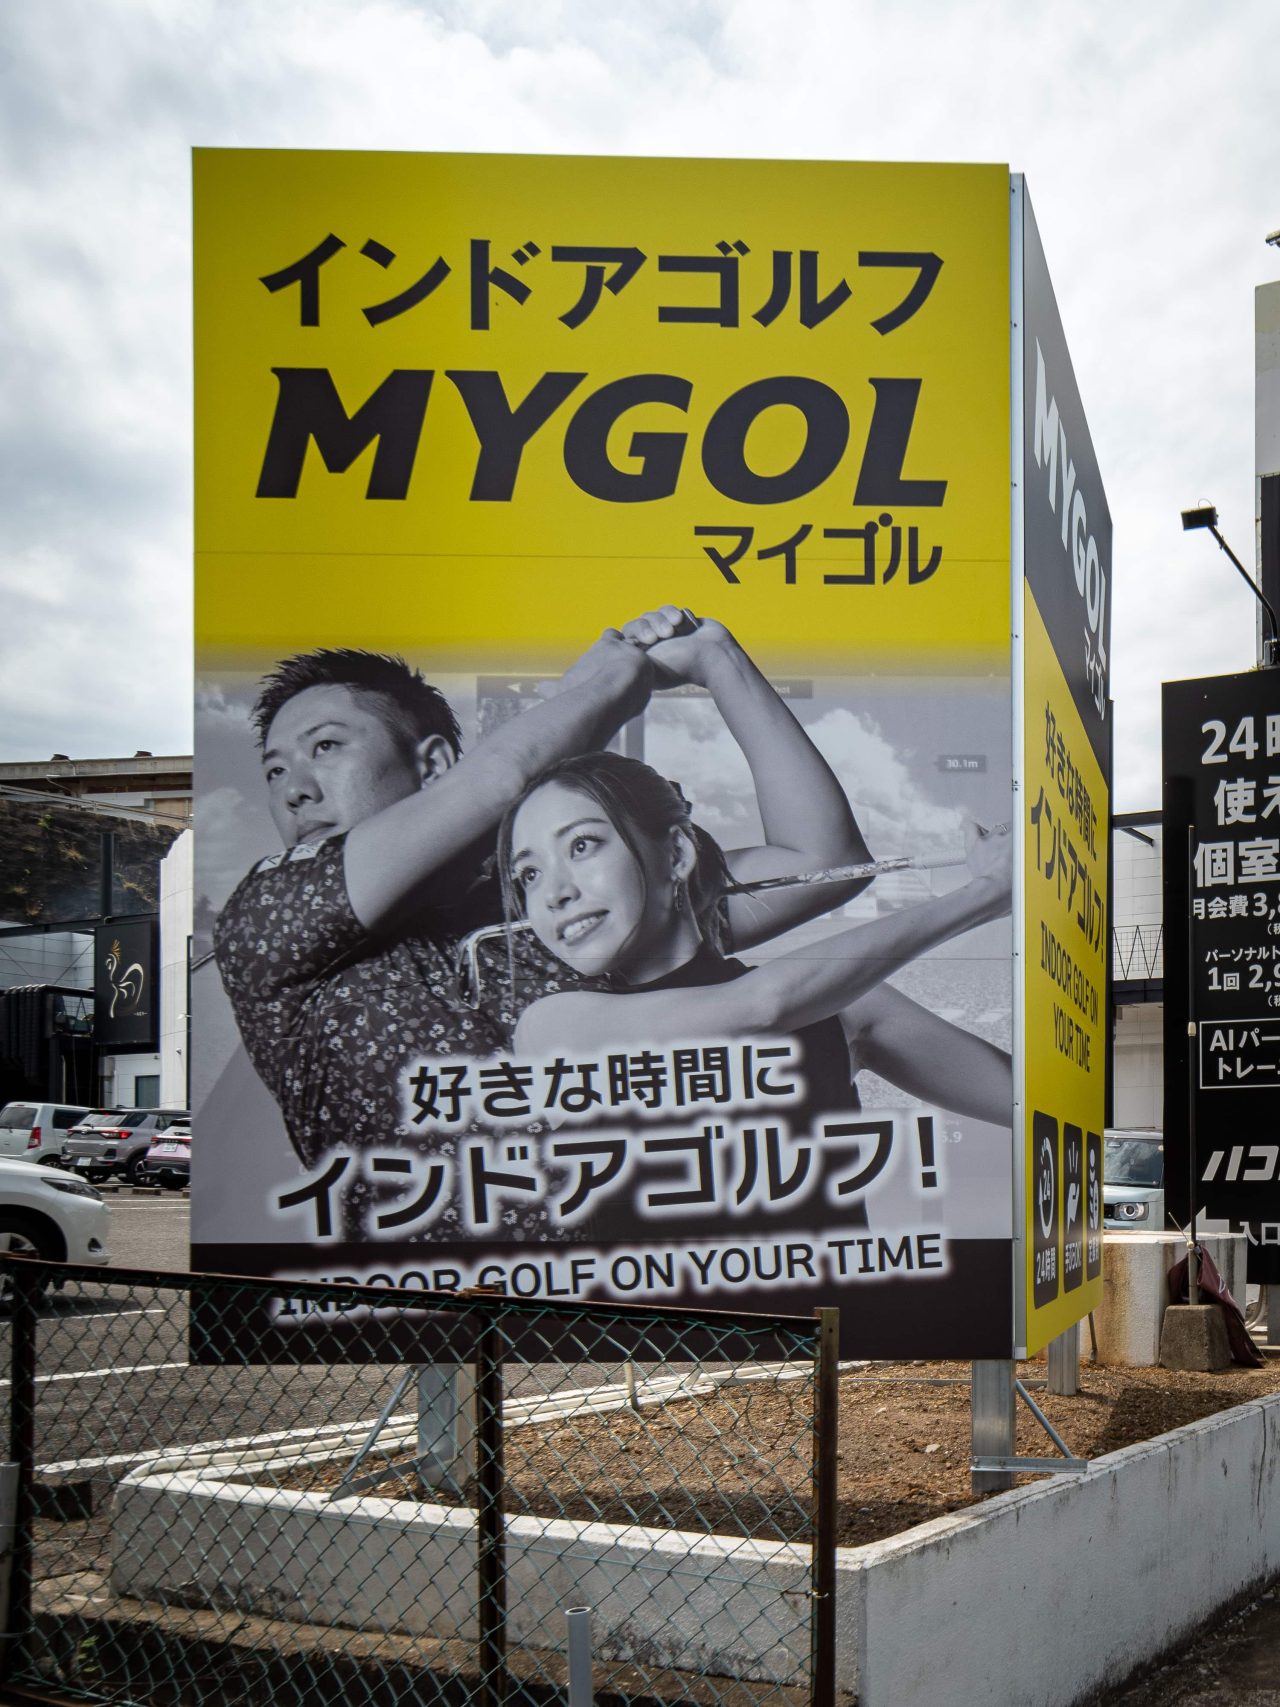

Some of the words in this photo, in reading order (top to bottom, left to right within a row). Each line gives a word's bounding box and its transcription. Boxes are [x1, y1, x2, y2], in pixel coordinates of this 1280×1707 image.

[258, 232, 945, 337] インドアゴルフ
[254, 366, 948, 508] MYGOL
[694, 513, 943, 585] マイゴル
[1034, 335, 1107, 674] MYGOL
[1044, 700, 1099, 862] 好きな時間に
[410, 1045, 796, 1122] 好きな時間に
[277, 1115, 940, 1237] インドアゴルフ!
[478, 1258, 597, 1298] GOLF
[610, 1251, 679, 1291] ON
[687, 1243, 817, 1284] YOUR
[826, 1233, 944, 1277] TIME
